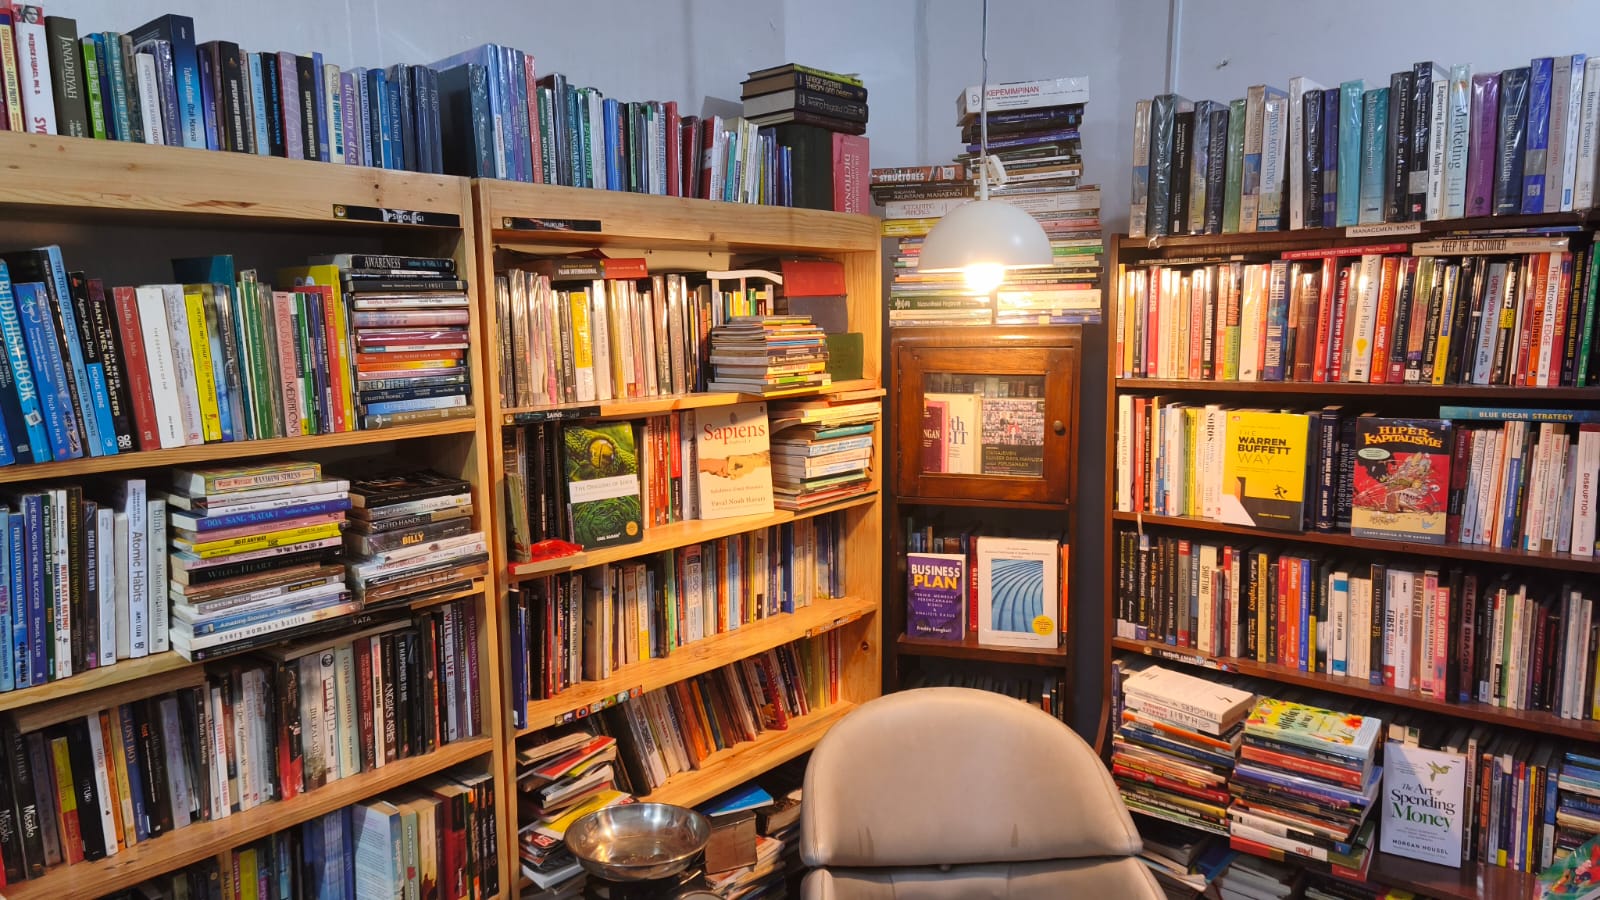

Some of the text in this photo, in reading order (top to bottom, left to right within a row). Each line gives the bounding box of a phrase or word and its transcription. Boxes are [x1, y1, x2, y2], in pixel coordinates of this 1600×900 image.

[57, 36, 77, 99] JANADRIYAH
[986, 86, 1040, 97] KEPEMIMPINAN
[1435, 85, 1446, 121] Engineering
[344, 84, 354, 130] dictionary
[1582, 91, 1594, 158] Business Forecasting
[1448, 104, 1468, 169] Marketing
[1266, 138, 1277, 185] ACCOUNTING
[1433, 152, 1441, 175] Analysis
[1501, 139, 1515, 182] Marketing
[879, 172, 925, 182] STRUCTURES
[1442, 239, 1506, 252] KEEP CUSTOMER
[364, 256, 400, 268] AWARENESS
[1550, 265, 1559, 281] THE
[1337, 279, 1347, 295] What
[1380, 290, 1391, 325] CONFLICT
[279, 301, 289, 338] MARCUS
[1335, 319, 1343, 336] Steve
[1359, 313, 1370, 337] Brain
[1531, 310, 1543, 348] business
[1333, 337, 1342, 351] Jobs
[1377, 326, 1386, 348] WORK
[1542, 324, 1553, 346] EDGE
[94, 301, 104, 326] MANY
[103, 353, 112, 377] MANY
[109, 379, 120, 417] MASTERS
[106, 340, 115, 363] BRIAN
[282, 340, 293, 380] AURELIUS
[14, 361, 35, 401] BOOK
[1207, 413, 1215, 442] SOROS
[1501, 412, 1529, 420] OCEAN
[1532, 413, 1574, 421] STRATEGY
[703, 423, 766, 445] Sapiens
[1238, 436, 1287, 447] WARREN
[1364, 432, 1442, 448] KAPITALISME
[1379, 426, 1435, 437] HIPER-
[1237, 443, 1292, 456] BUFFETT
[1581, 473, 1590, 516] DISRUPTION
[153, 509, 166, 534] blink
[402, 532, 425, 545] BILLY
[132, 532, 144, 602] Atomic Habits
[912, 564, 960, 576] BUSINESS
[914, 574, 957, 589] PLAN
[1201, 565, 1210, 595] SHIFTING
[1248, 582, 1257, 611] Prophecy
[1465, 582, 1474, 626] SILICON
[1170, 710, 1198, 724] HABIT
[1414, 784, 1432, 795] Art
[1391, 789, 1456, 815] Spending
[23, 805, 38, 838] Masako
[1392, 802, 1452, 832] Money
[1392, 840, 1448, 855] MORGAN HOUSEL
